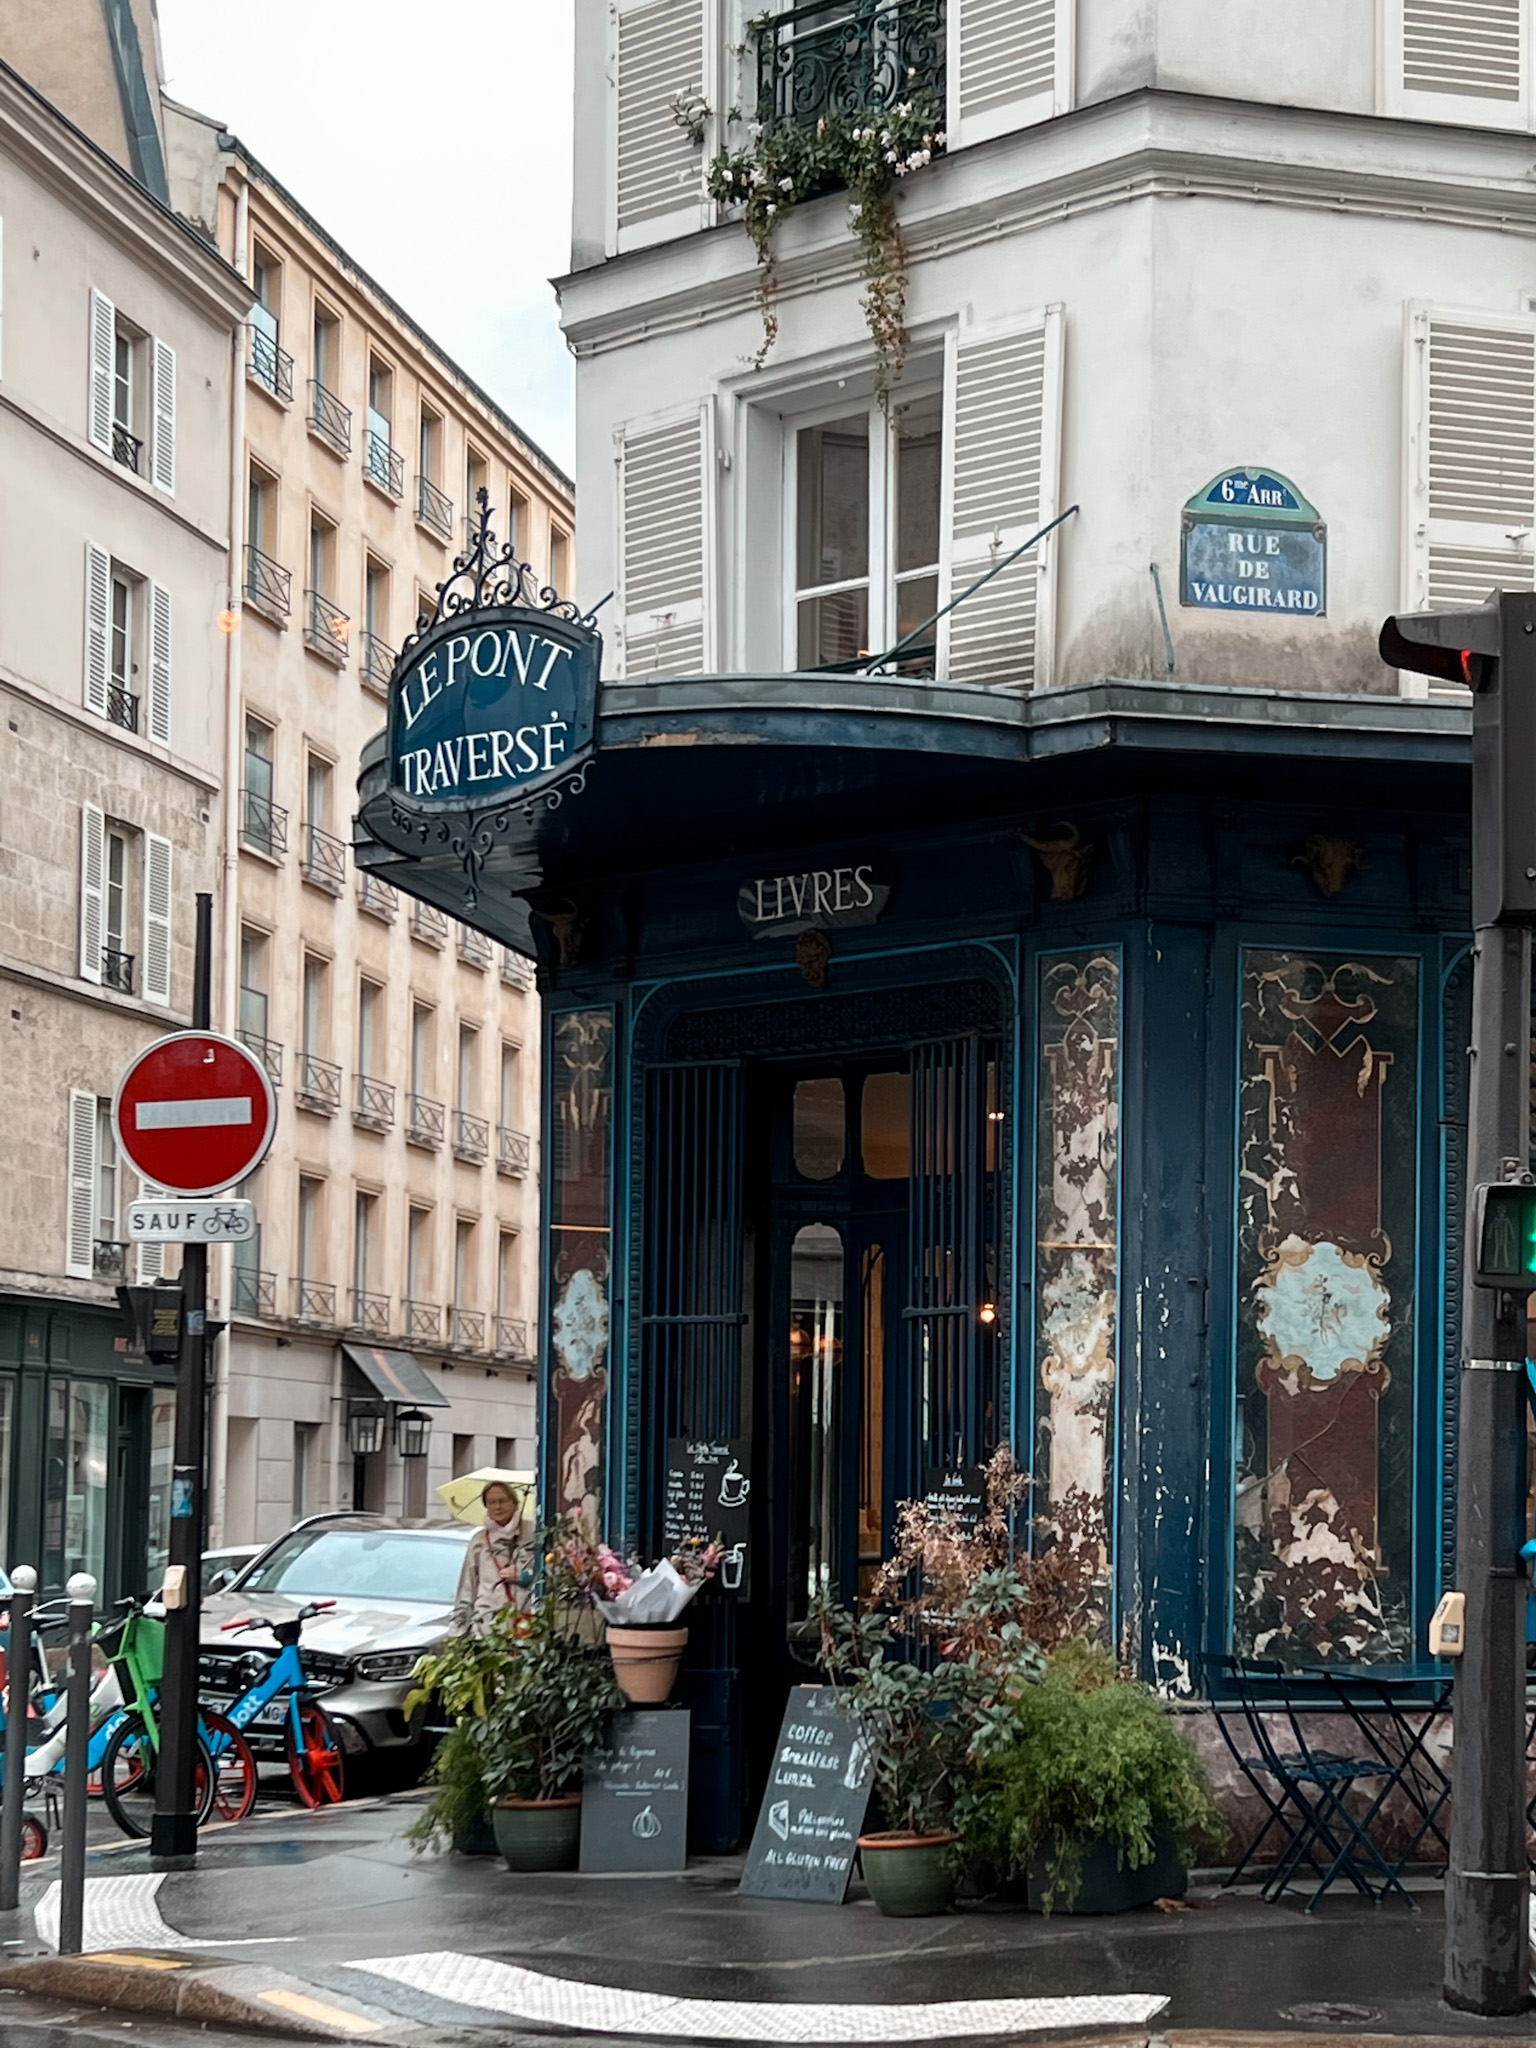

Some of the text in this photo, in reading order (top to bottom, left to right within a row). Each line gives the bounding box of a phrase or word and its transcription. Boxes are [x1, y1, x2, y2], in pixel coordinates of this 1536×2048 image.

[1228, 533, 1280, 555] RUE
[1238, 560, 1270, 579] DE
[1192, 582, 1318, 610] VAUGIRARD
[400, 629, 573, 730] LE PONT
[400, 711, 568, 796] TRAVERSÉ
[754, 865, 873, 922] LIVRES
[133, 1213, 198, 1231] SAUF
[775, 1767, 816, 1788] Lunch
